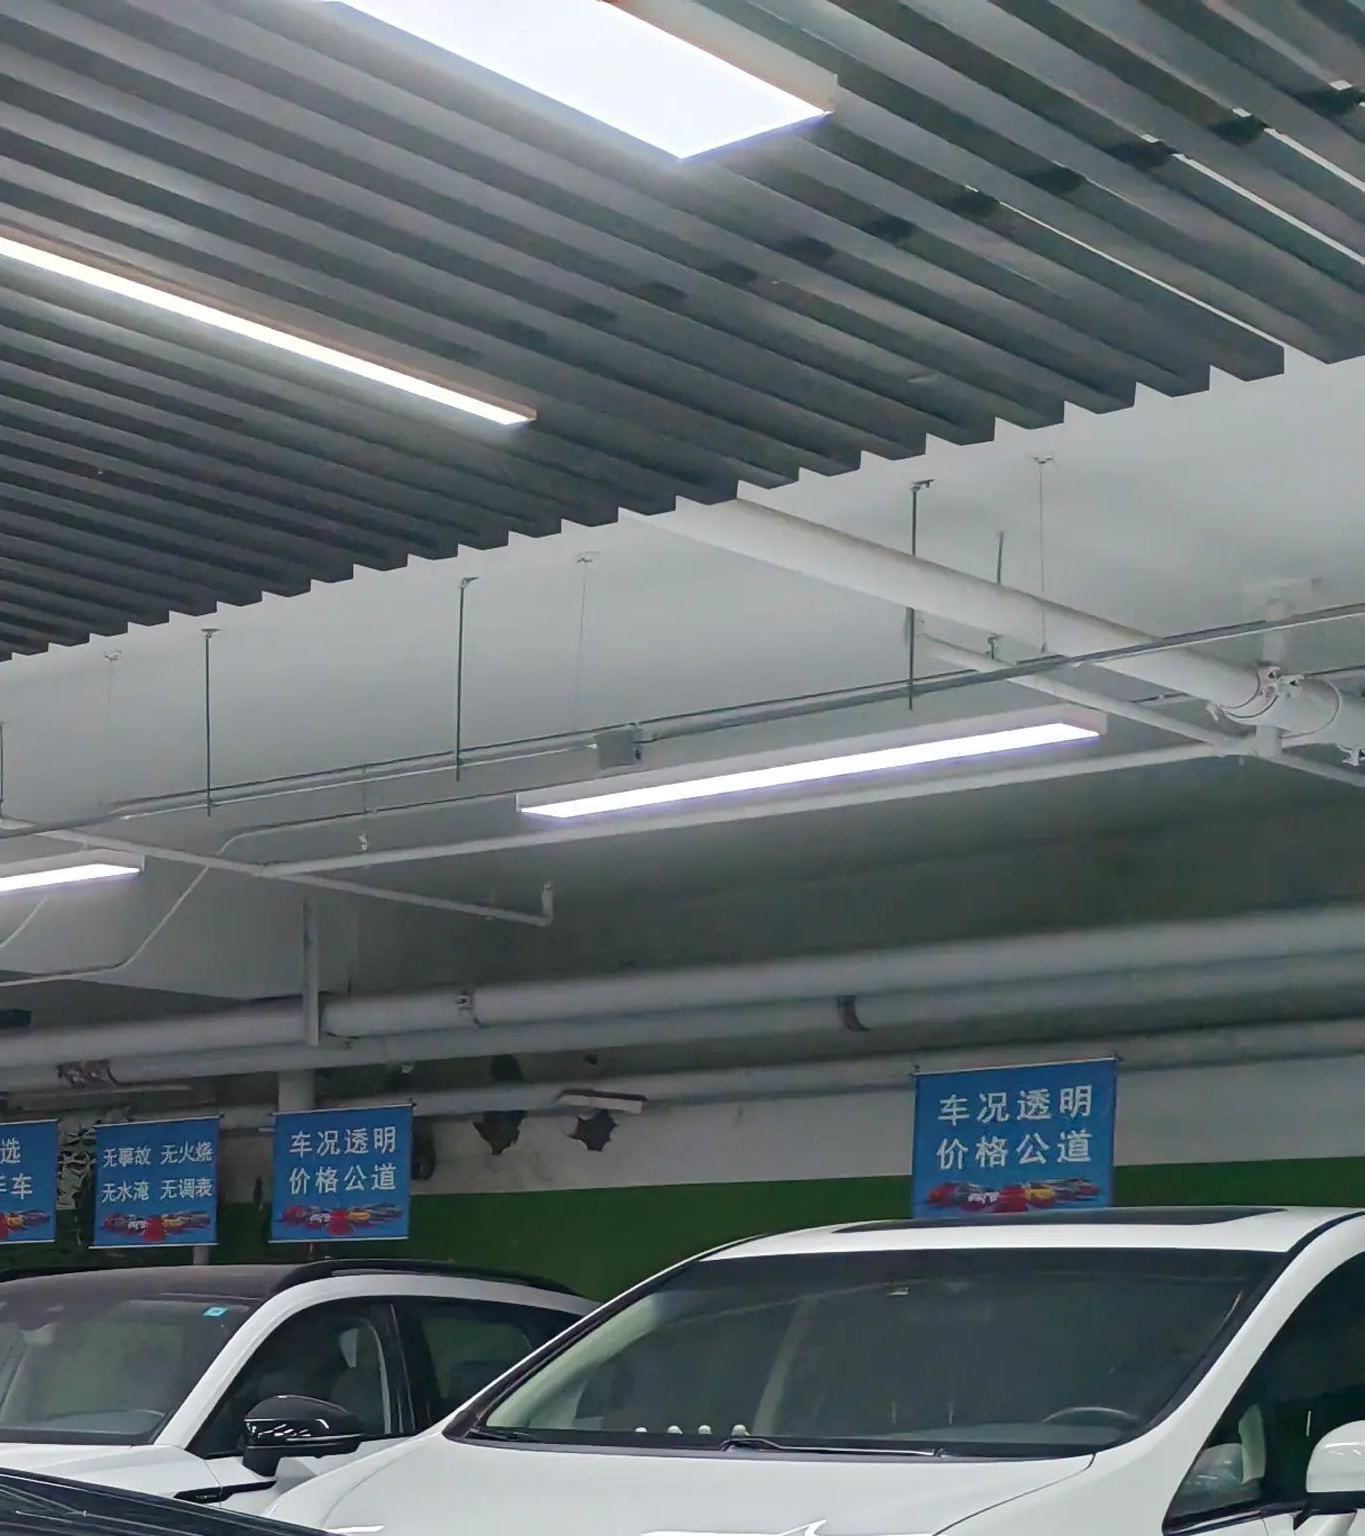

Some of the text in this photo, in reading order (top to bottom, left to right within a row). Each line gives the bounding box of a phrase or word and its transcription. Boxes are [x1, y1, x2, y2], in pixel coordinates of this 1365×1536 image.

[938, 1084, 1093, 1126] 车况透明
[103, 1140, 213, 1168] 无事故 无火烧
[290, 1126, 397, 1159] 车况透明
[936, 1129, 1093, 1170] 价格公道
[160, 1177, 213, 1200] 无调表
[289, 1164, 397, 1197] 价格公道
